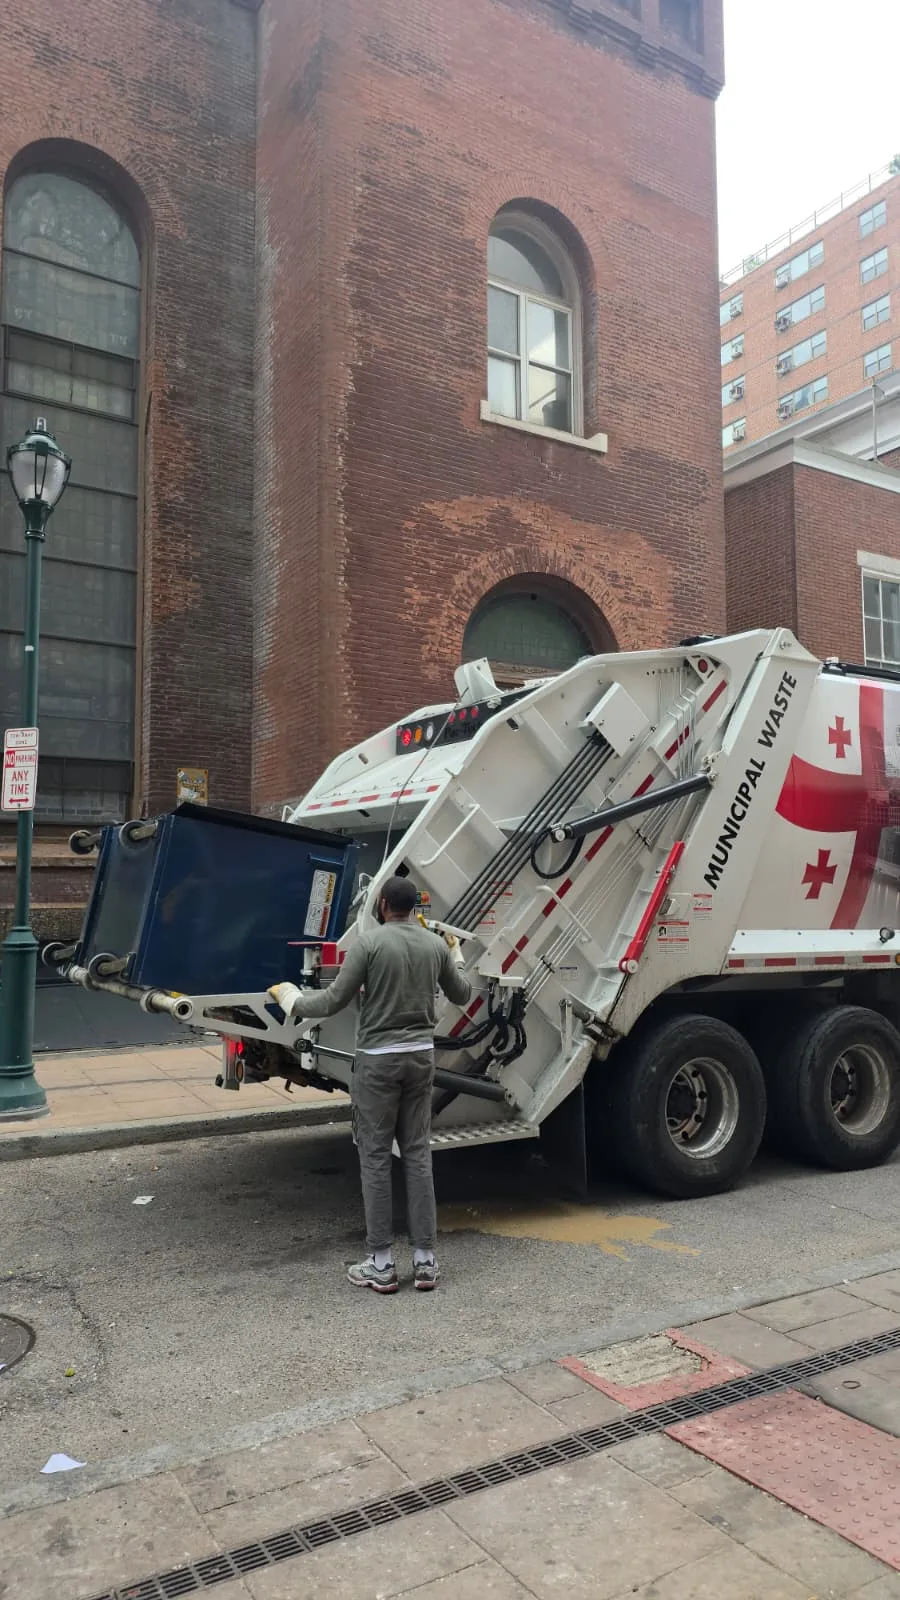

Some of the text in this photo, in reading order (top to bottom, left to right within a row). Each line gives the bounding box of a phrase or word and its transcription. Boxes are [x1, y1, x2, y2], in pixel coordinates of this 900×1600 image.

[6, 753, 15, 765] NO
[12, 770, 29, 782] ANY
[704, 671, 797, 890] MUNICIPAL WASTE
[10, 784, 30, 795] TIME
